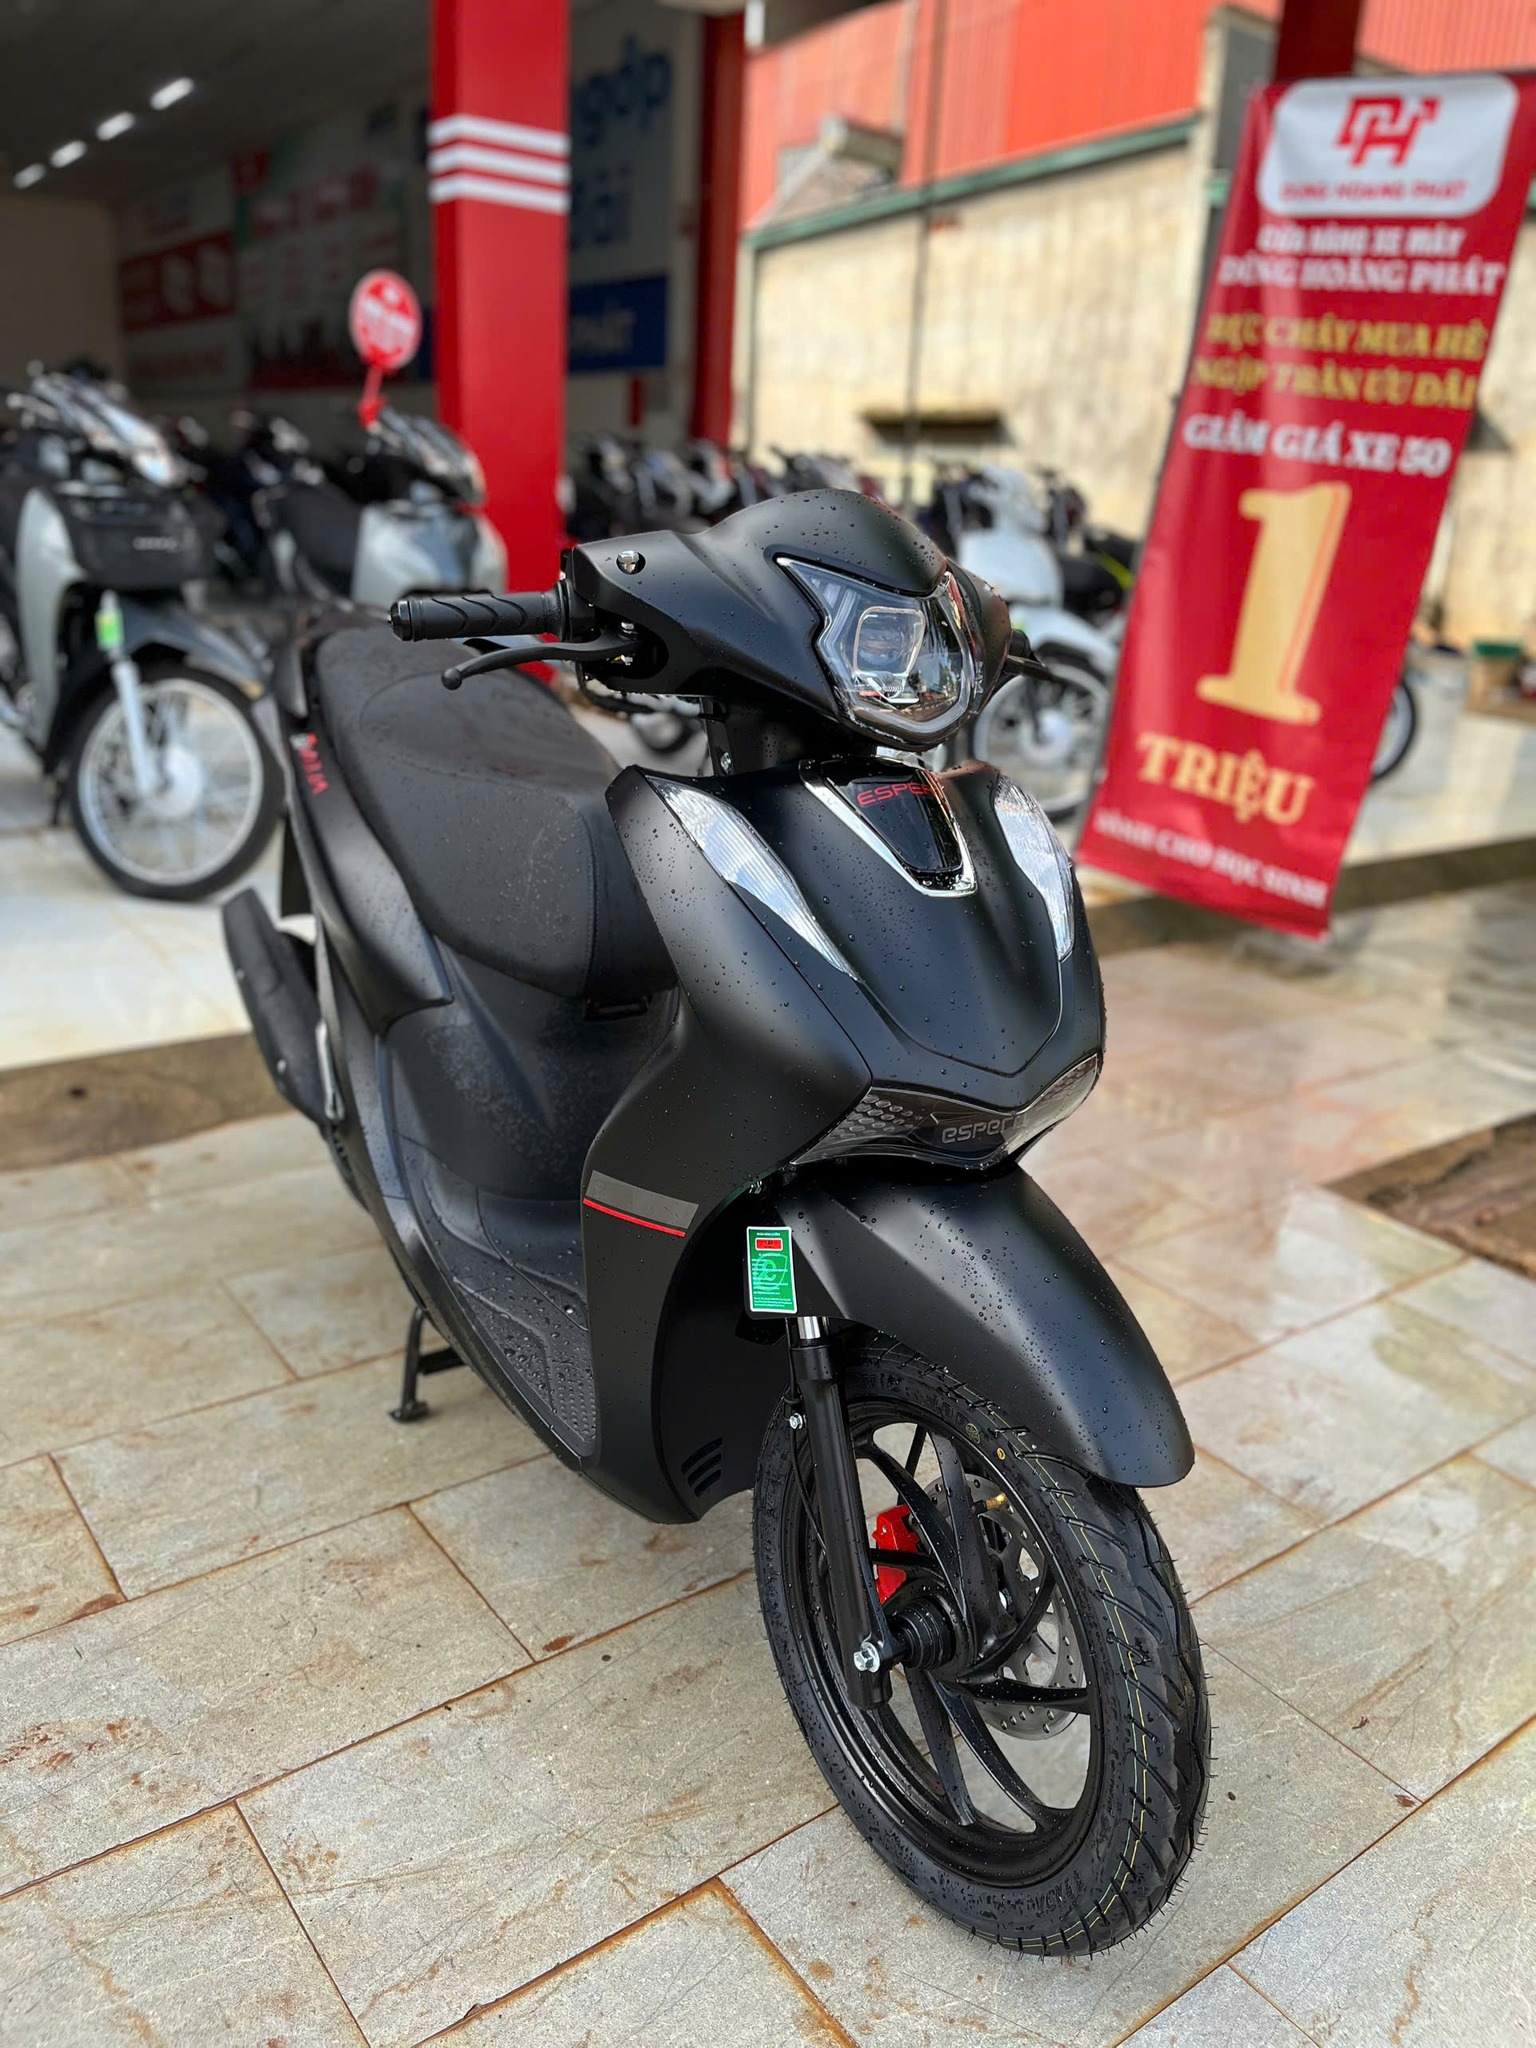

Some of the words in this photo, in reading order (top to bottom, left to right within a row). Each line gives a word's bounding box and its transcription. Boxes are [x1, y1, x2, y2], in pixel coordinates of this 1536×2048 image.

[1344, 430, 1401, 472] XE
[1399, 436, 1452, 478] 50
[1195, 480, 1353, 727] 1
[1136, 731, 1316, 826] TRIỆU
